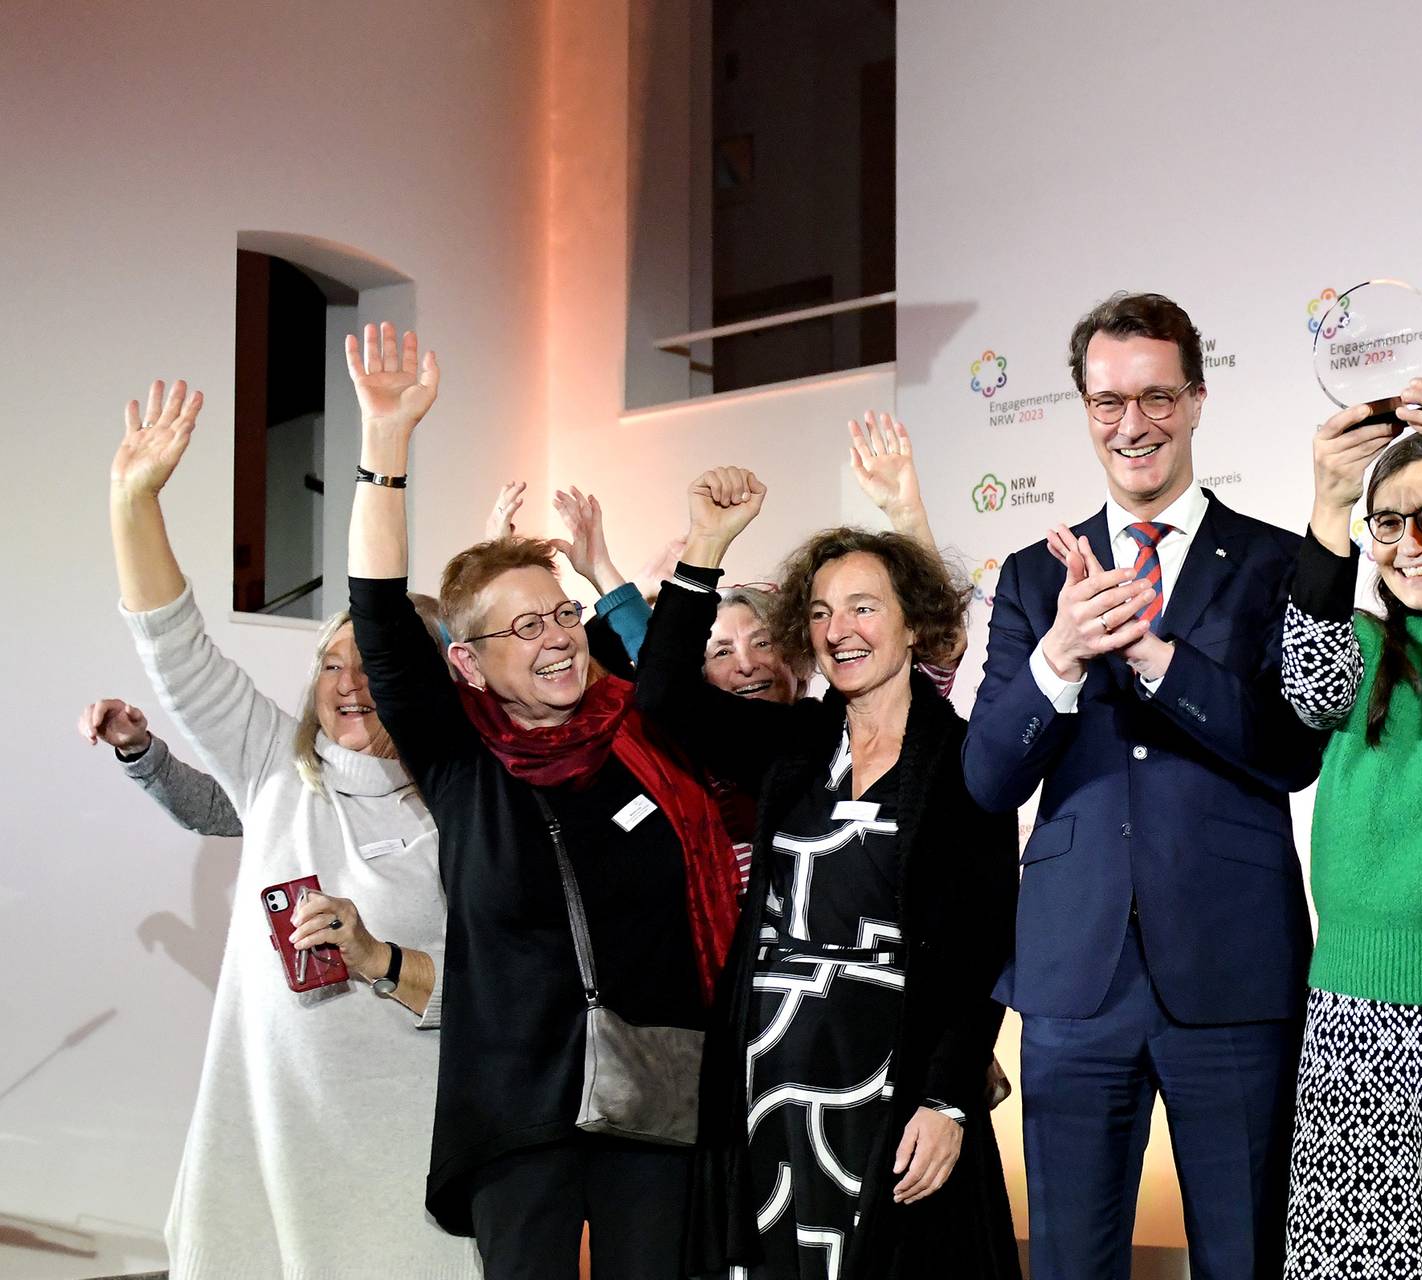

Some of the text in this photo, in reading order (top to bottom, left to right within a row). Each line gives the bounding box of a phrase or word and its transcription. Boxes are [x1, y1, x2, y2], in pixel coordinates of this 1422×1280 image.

[1330, 355, 1361, 371] NRW
[988, 390, 1081, 413] Engagementpreis
[988, 407, 1044, 427] NRW 2023
[1010, 475, 1037, 491] NRW
[1010, 490, 1055, 506] Stiftung
